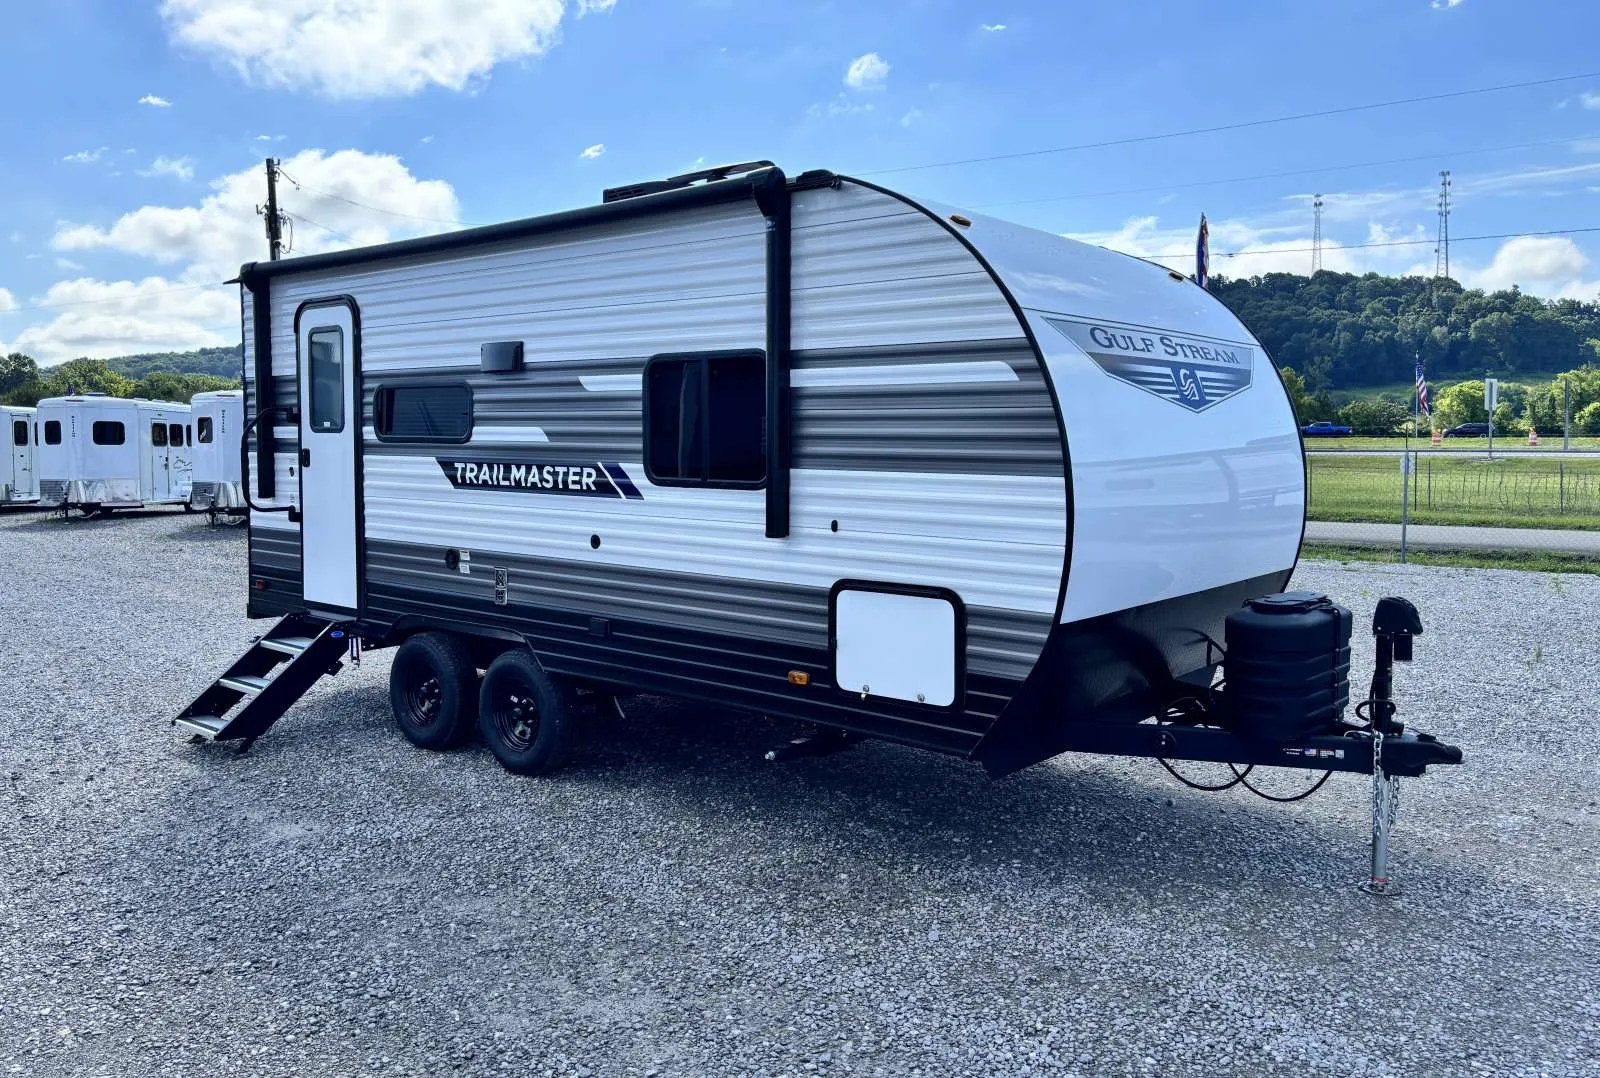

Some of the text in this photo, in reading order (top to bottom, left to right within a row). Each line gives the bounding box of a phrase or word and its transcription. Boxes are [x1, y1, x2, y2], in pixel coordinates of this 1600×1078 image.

[1089, 326, 1240, 365] GULF STREAM
[454, 462, 597, 491] TRAILMASTER
